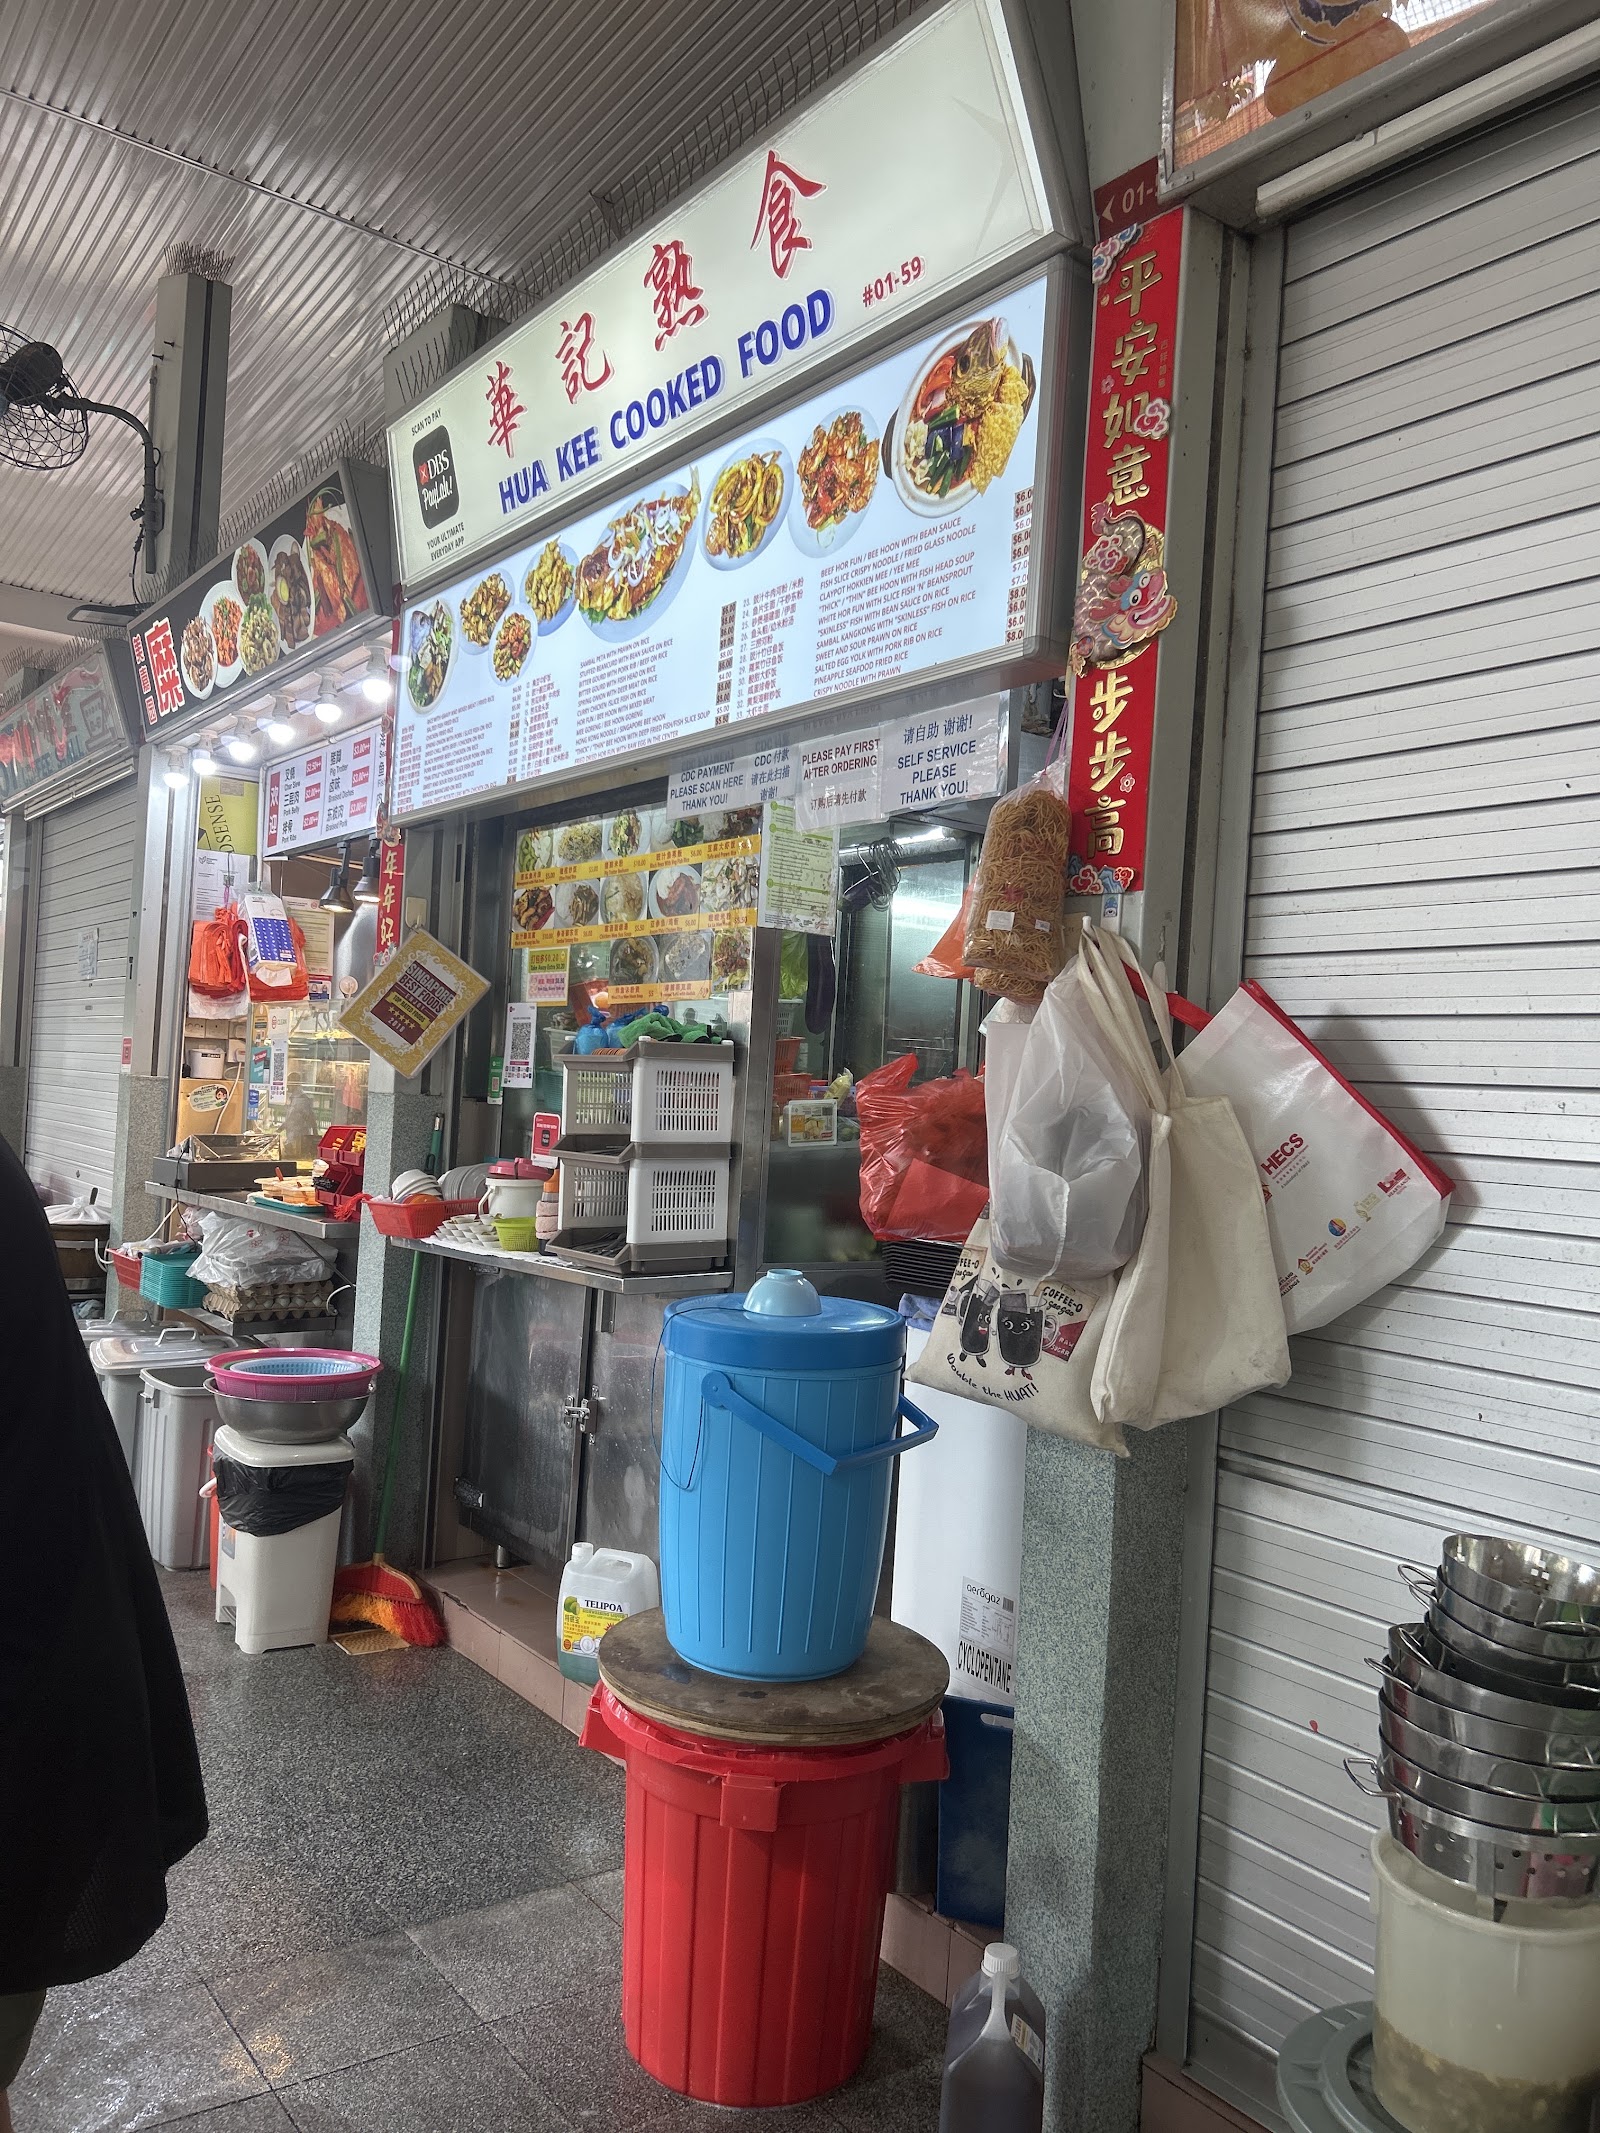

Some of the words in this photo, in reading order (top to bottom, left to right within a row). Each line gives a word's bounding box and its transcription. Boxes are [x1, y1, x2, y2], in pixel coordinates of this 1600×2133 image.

[1121, 181, 1157, 215] 01-
[862, 256, 923, 307] #01-59
[485, 150, 827, 459] 華記熟食
[1102, 249, 1163, 506] 平安如意
[498, 463, 547, 514] HUA
[555, 426, 601, 482] KEE
[608, 354, 722, 449] COOKED
[737, 288, 835, 378] FOOD
[411, 420, 425, 436] SCAN
[424, 414, 432, 426] TO
[431, 407, 443, 422] PAY
[427, 449, 450, 480] DBS
[427, 535, 441, 550] YOUR
[440, 522, 465, 542] ULTIMATE
[430, 541, 454, 562] EVERYDAY
[454, 535, 465, 549] APP
[821, 566, 835, 577] BEEF
[835, 560, 849, 572] HOR
[849, 555, 863, 566] FUN
[867, 549, 879, 560] BEE
[880, 540, 900, 555] HOON
[901, 533, 919, 547] WITH
[919, 526, 938, 540] BEAN
[939, 516, 961, 532] SAUCE
[820, 579, 833, 589] FISH
[833, 572, 850, 584] SLICE
[850, 564, 872, 578] CRISPY
[872, 554, 899, 570] NOODLE
[904, 544, 923, 558] FRIED
[924, 536, 945, 551] GLASS
[946, 524, 976, 543] NOODLE
[866, 586, 878, 596] BEE
[879, 578, 900, 592] HOON
[900, 572, 918, 585] WITH
[918, 566, 934, 578] FISH
[935, 559, 954, 572] HEAD
[955, 551, 975, 565] SOUP
[818, 613, 837, 625] WHITE
[837, 608, 851, 619] HOR
[851, 603, 865, 614] FUN
[865, 597, 882, 609] WITH
[883, 591, 900, 603] SLICE
[901, 585, 916, 597] FISH
[927, 565, 973, 588] BEANSPROUT
[819, 586, 846, 601] CLAYPOT
[846, 575, 874, 592] HOKKIEN
[875, 570, 888, 581] MEE
[893, 564, 905, 575] YEE
[905, 558, 920, 570] MEE
[816, 636, 840, 649] SAMBAL
[840, 624, 876, 642] KANGKONG
[876, 618, 894, 630] WITH
[931, 600, 947, 612] FISH
[947, 596, 959, 607] ON
[960, 591, 976, 603] RICE
[849, 616, 863, 626] FISH
[863, 610, 881, 622] WITH
[881, 604, 899, 616] BEAN
[900, 596, 921, 610] SAUCE
[922, 592, 933, 602] ON
[934, 586, 950, 598] RICE
[814, 661, 836, 674] SALTED
[837, 657, 849, 667] EGG
[850, 652, 866, 663] YOLK
[866, 646, 884, 658] WITH
[884, 640, 902, 652] PORK
[903, 637, 914, 647] RIB
[915, 633, 926, 643] ON
[927, 628, 943, 639] RICE
[815, 649, 835, 662] SWEET
[834, 645, 849, 655] AND
[849, 639, 867, 651] SOUR
[867, 631, 891, 645] PRAWN
[891, 628, 902, 638] ON
[903, 623, 918, 634] RICE
[813, 686, 833, 697] CRISPY
[834, 678, 859, 691] NOODLE
[860, 673, 877, 684] WITH
[877, 666, 901, 679] PRAWN
[814, 670, 845, 686] PINEAPPLE
[845, 661, 874, 676] SEAFOOD
[875, 655, 893, 667] FRIED
[894, 651, 909, 662] RICE
[903, 721, 939, 745] 请自助
[943, 714, 973, 736] 谢谢!
[754, 754, 772, 767] CDC
[773, 748, 790, 764] 付款
[802, 748, 833, 766] PLEASE
[834, 744, 852, 758] PAY
[853, 738, 881, 754] FIRST
[803, 765, 829, 780] AFTER
[831, 755, 877, 774] ORDERING
[897, 751, 924, 770] SELF
[926, 740, 977, 763] SERVICE
[1083, 670, 1134, 862] 步步高
[670, 784, 698, 799] PLEASE
[699, 779, 721, 794] SCAN
[722, 774, 744, 789] HERE
[681, 770, 696, 783] CDC
[697, 762, 735, 779] PAYMENT
[751, 764, 791, 786] 请在此扫描
[912, 763, 957, 784] PLEASE
[682, 797, 707, 812] THANK
[709, 793, 728, 806] YOU!
[810, 788, 867, 811] 订购后请先付款
[900, 785, 937, 805] THANK
[940, 780, 969, 797] YOU!
[381, 850, 398, 946] 年年好
[400, 974, 421, 994] BEST
[418, 988, 445, 1013] FOODS
[406, 962, 455, 1004] SINGAPORE
[1260, 1133, 1304, 1176] HECS
[1042, 1286, 1084, 1313] COFFEE-O
[1050, 1345, 1071, 1357] SUGAR
[946, 1353, 978, 1390] Double
[981, 1386, 1003, 1400] the
[1004, 1382, 1040, 1402] HUAT!
[584, 1599, 623, 1613] TELIPOA
[957, 1640, 1012, 1694] CYCLOPENTANE
